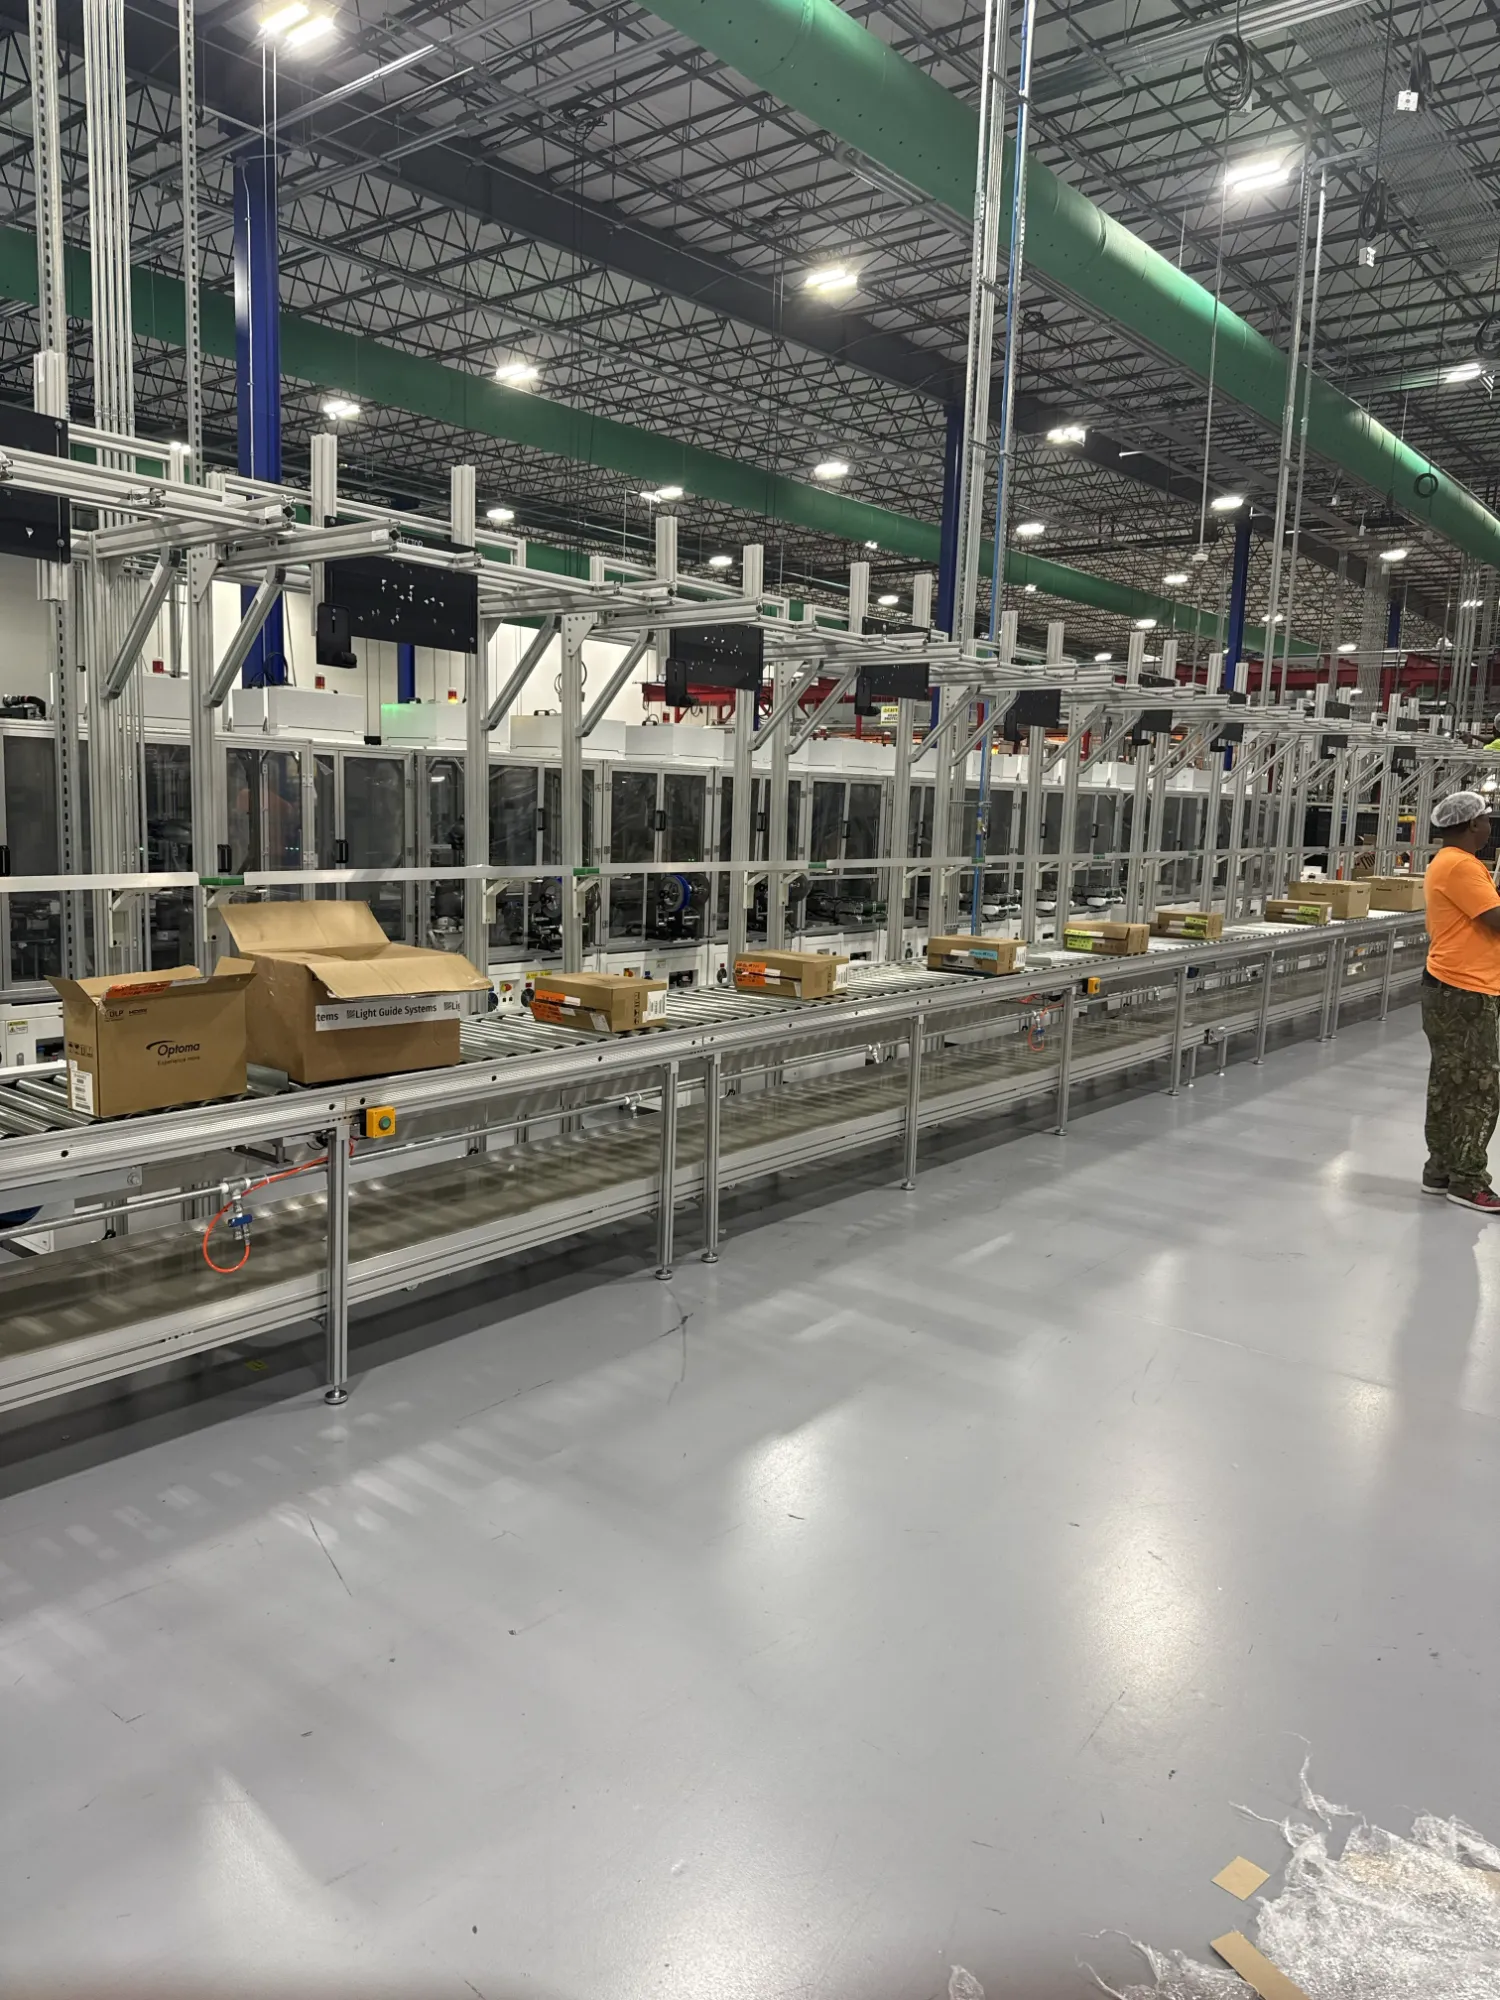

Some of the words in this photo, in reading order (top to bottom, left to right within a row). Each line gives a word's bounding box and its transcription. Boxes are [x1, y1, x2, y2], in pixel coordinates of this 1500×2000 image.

[109, 1009, 124, 1018] DLP
[316, 1013, 339, 1022] tems
[355, 1008, 377, 1020] Light
[379, 1007, 403, 1017] Guide
[404, 1003, 437, 1016] Systems
[157, 1043, 200, 1058] Optoma
